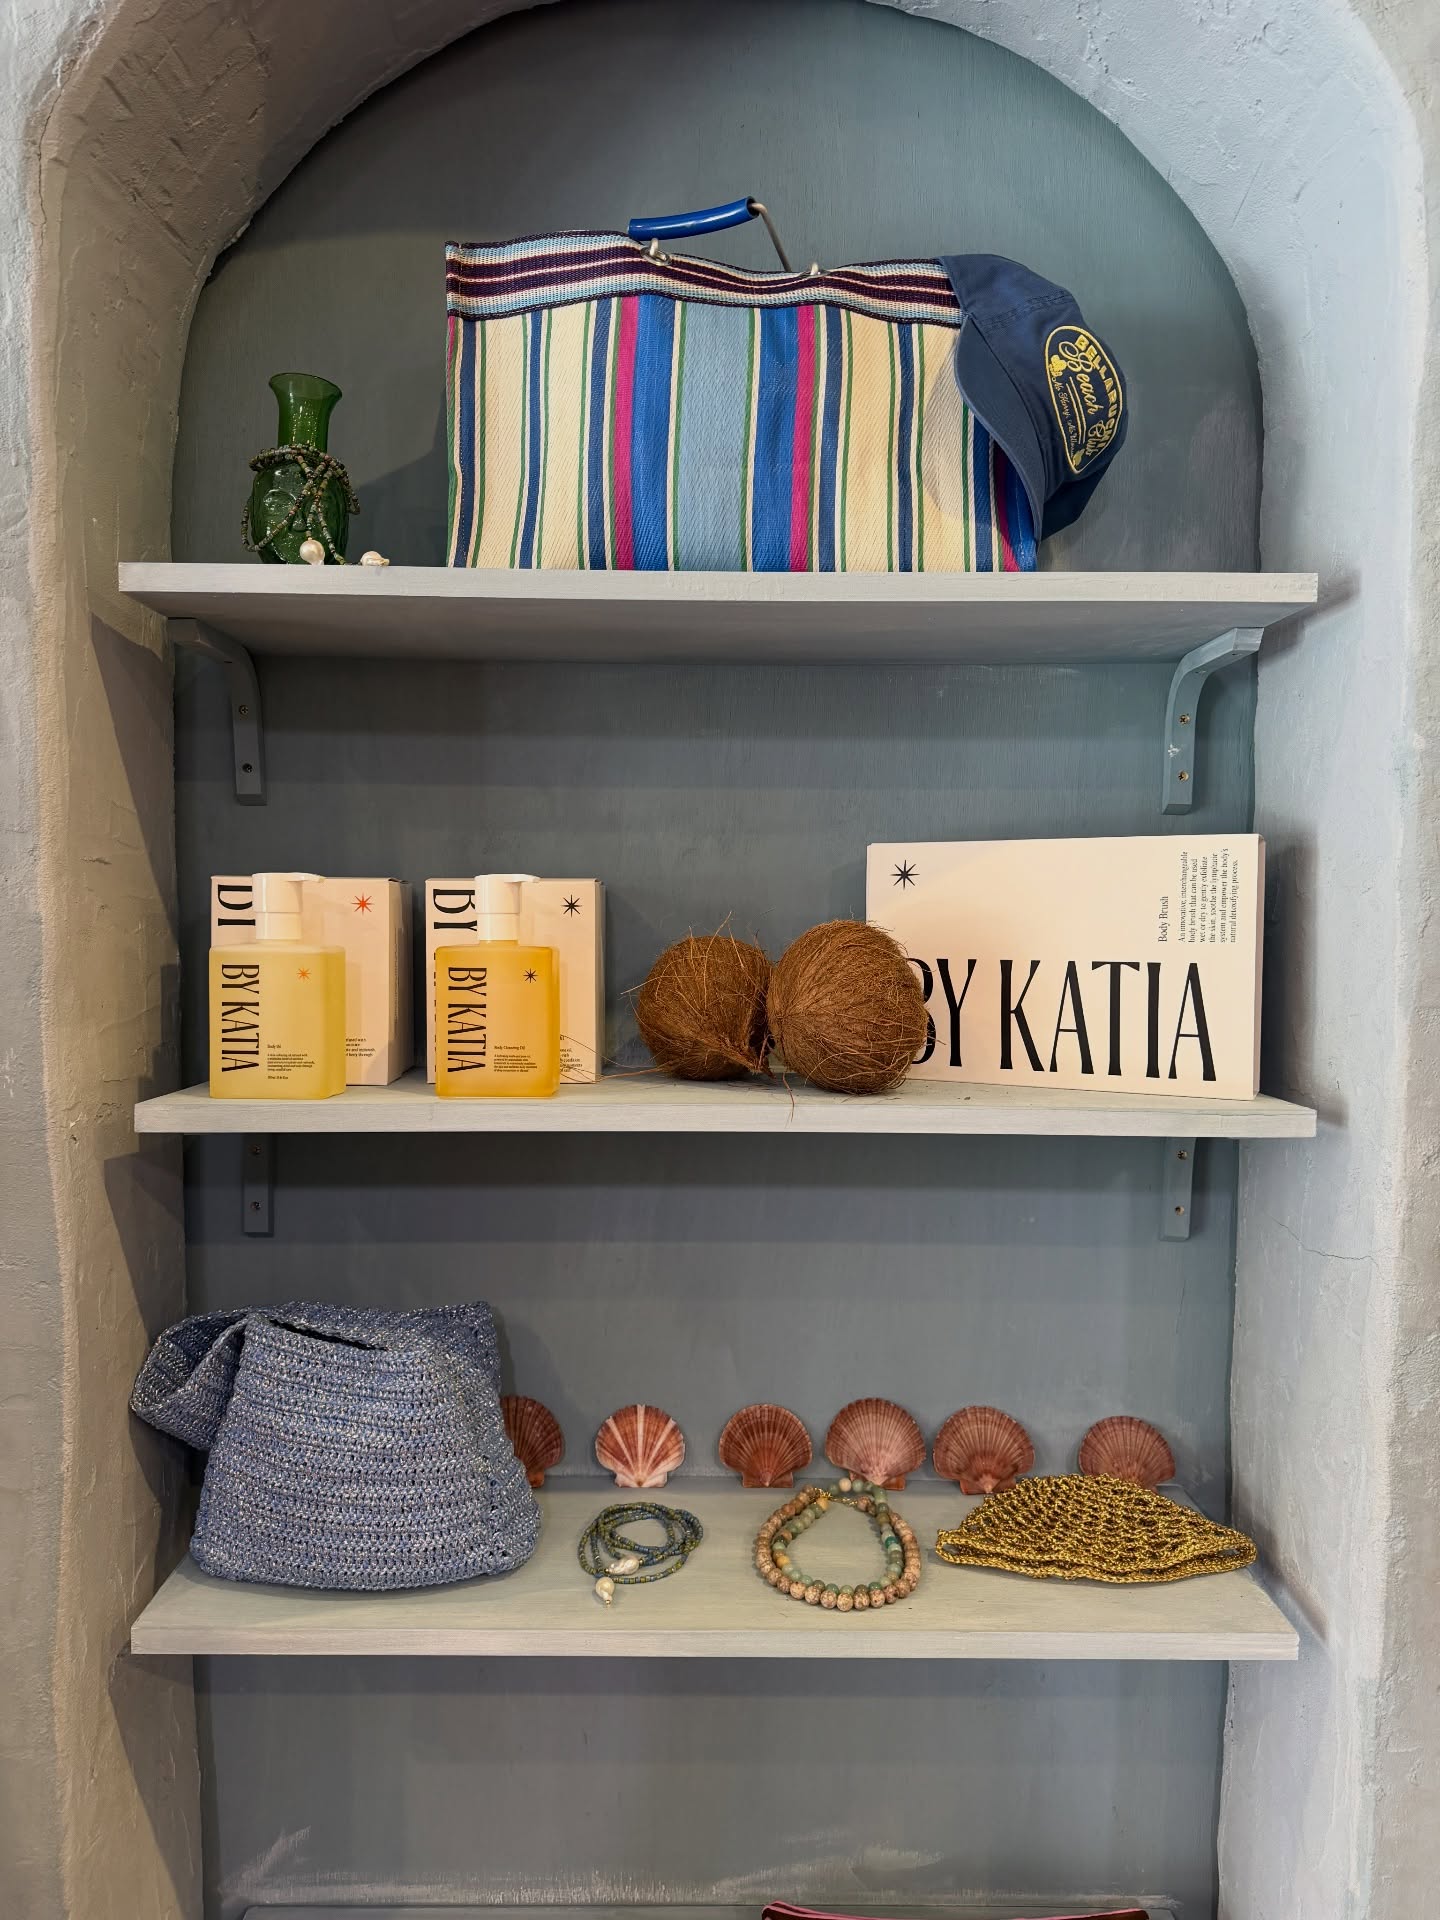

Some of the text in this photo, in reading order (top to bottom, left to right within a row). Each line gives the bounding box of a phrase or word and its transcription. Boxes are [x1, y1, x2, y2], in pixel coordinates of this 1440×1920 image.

[1058, 341, 1106, 456] Beach Club
[1180, 852, 1189, 898] interchangeable
[1200, 857, 1208, 882] exfoliate
[1210, 853, 1219, 883] lymphatic
[1189, 895, 1197, 907] that
[1199, 884, 1208, 902] gently
[1209, 885, 1217, 894] the
[1220, 881, 1228, 908] empower
[1230, 885, 1239, 919] detoxifying
[1158, 896, 1170, 942] Body Brush
[1199, 912, 1207, 922] dry
[1178, 933, 1186, 942] An
[1189, 927, 1197, 942] body
[1219, 923, 1227, 943] system
[221, 964, 259, 1073] BY KATIA
[447, 967, 487, 1073] BY KATIA
[1000, 959, 1216, 1081] KATIA
